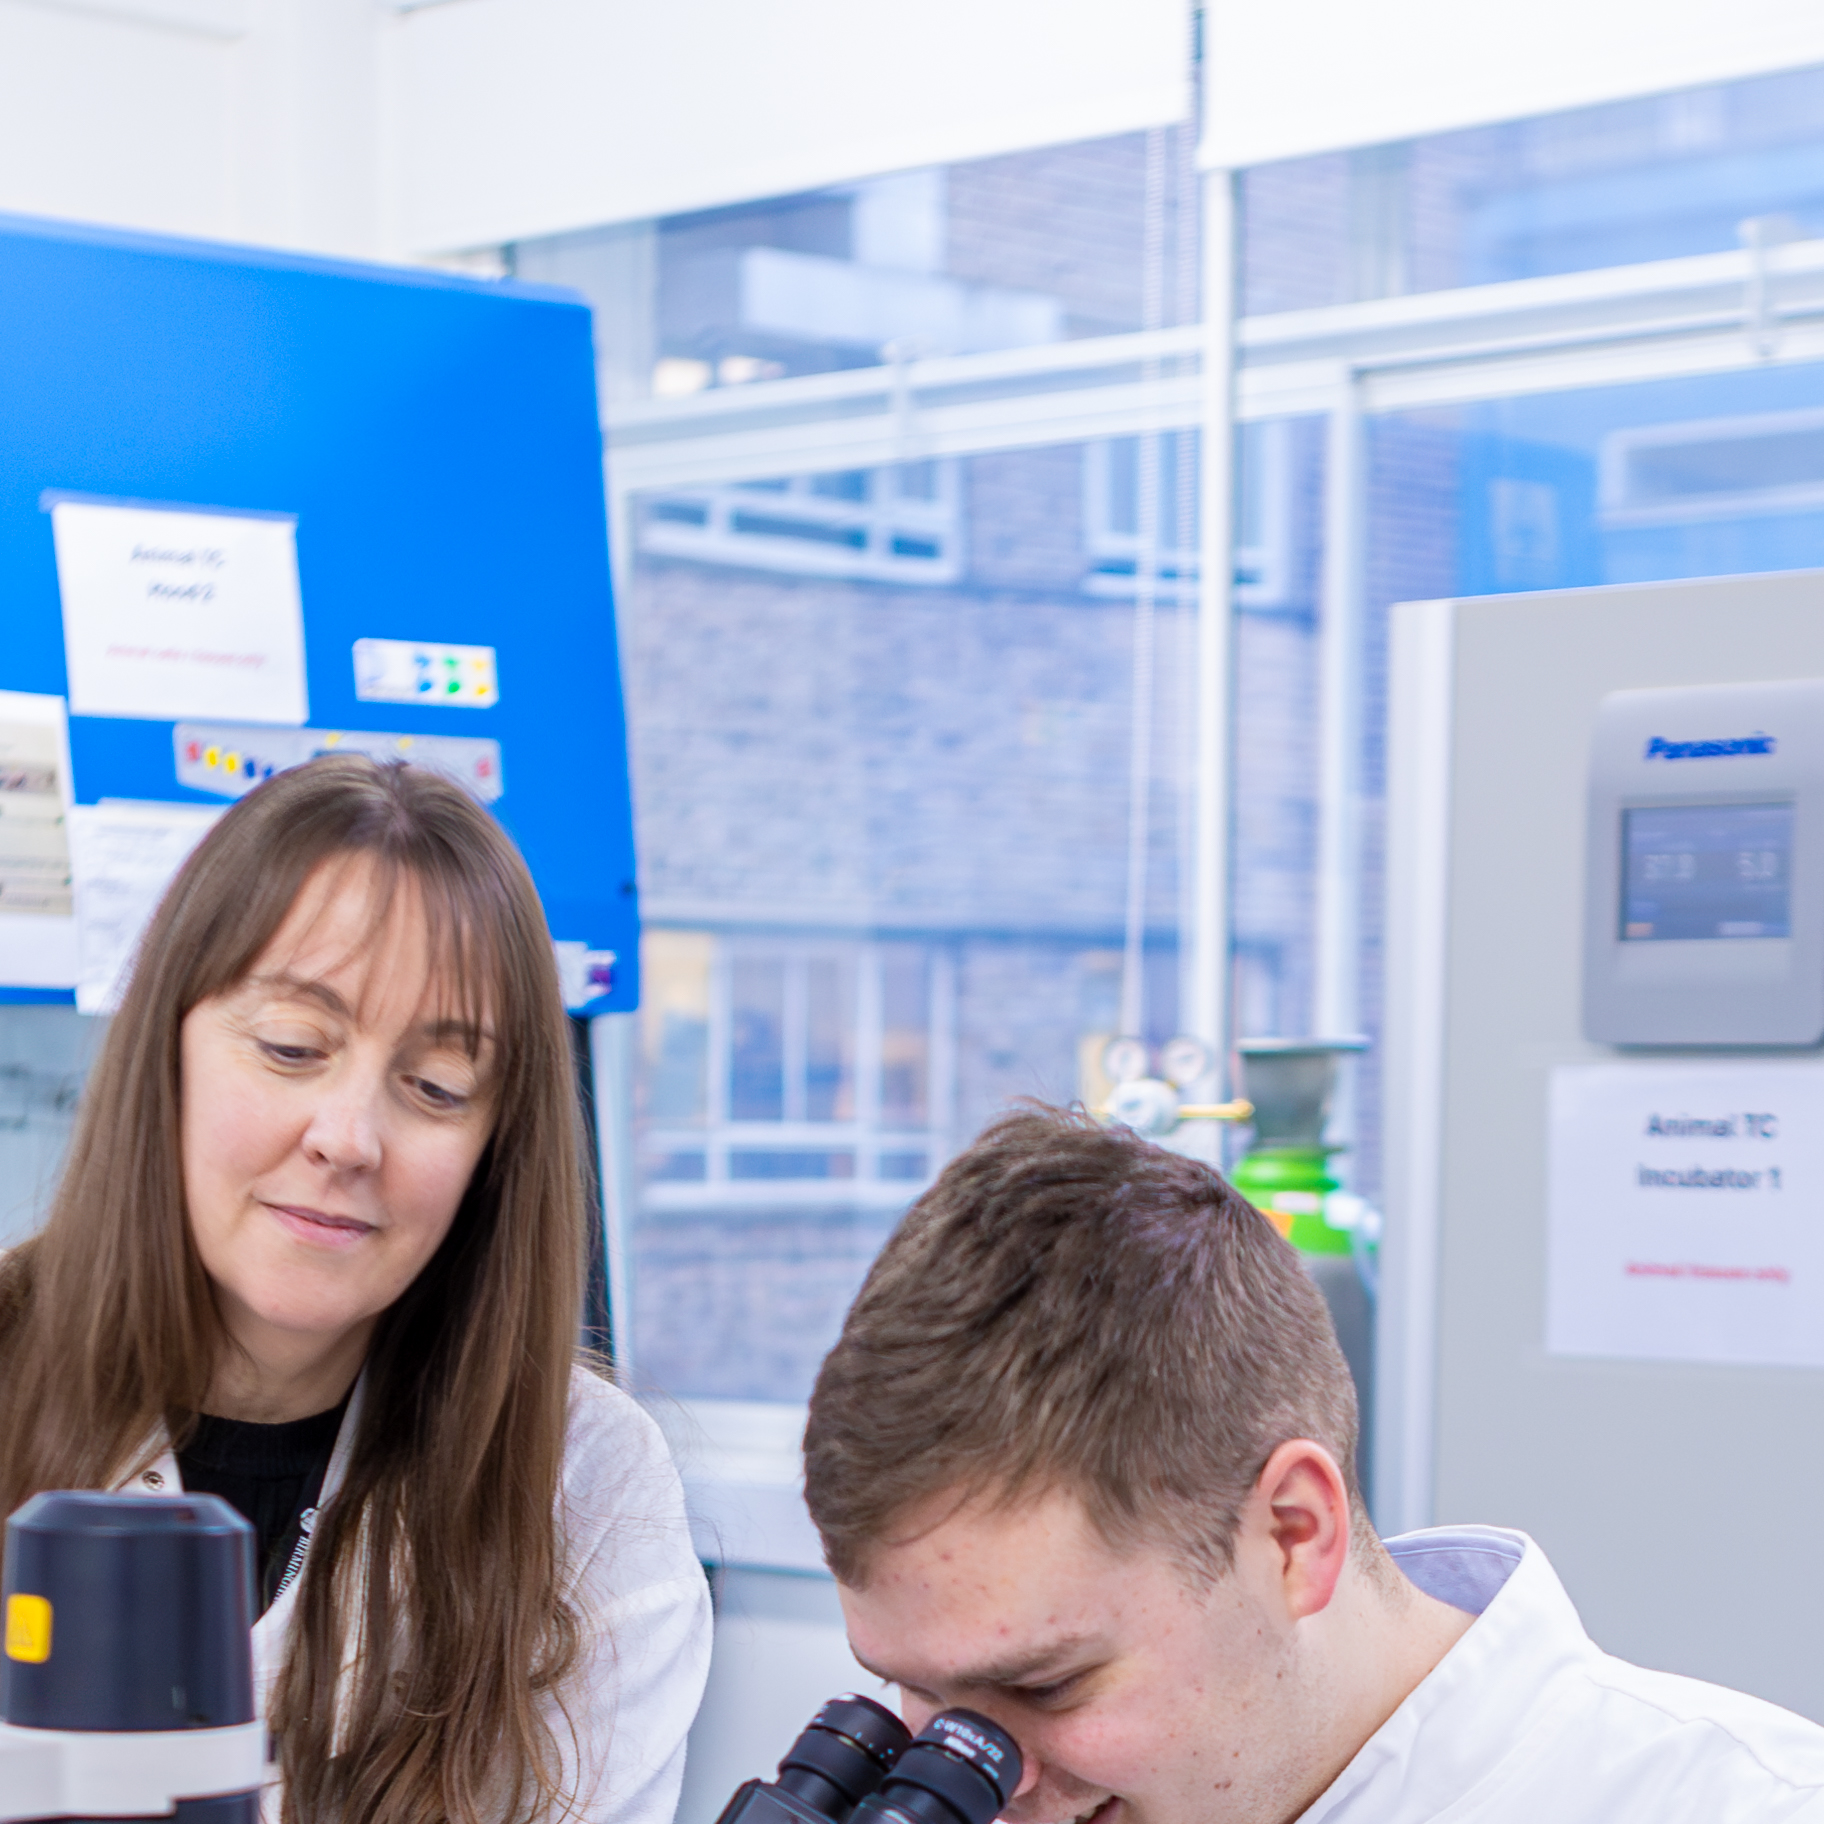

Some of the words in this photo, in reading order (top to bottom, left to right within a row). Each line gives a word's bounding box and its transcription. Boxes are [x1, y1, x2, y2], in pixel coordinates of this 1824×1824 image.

[1643, 730, 1776, 762] Panasonic
[1646, 1112, 1737, 1138] Animal
[1743, 1112, 1778, 1139] TC
[1636, 1163, 1761, 1189] Incubator
[1768, 1166, 1782, 1190] 1
